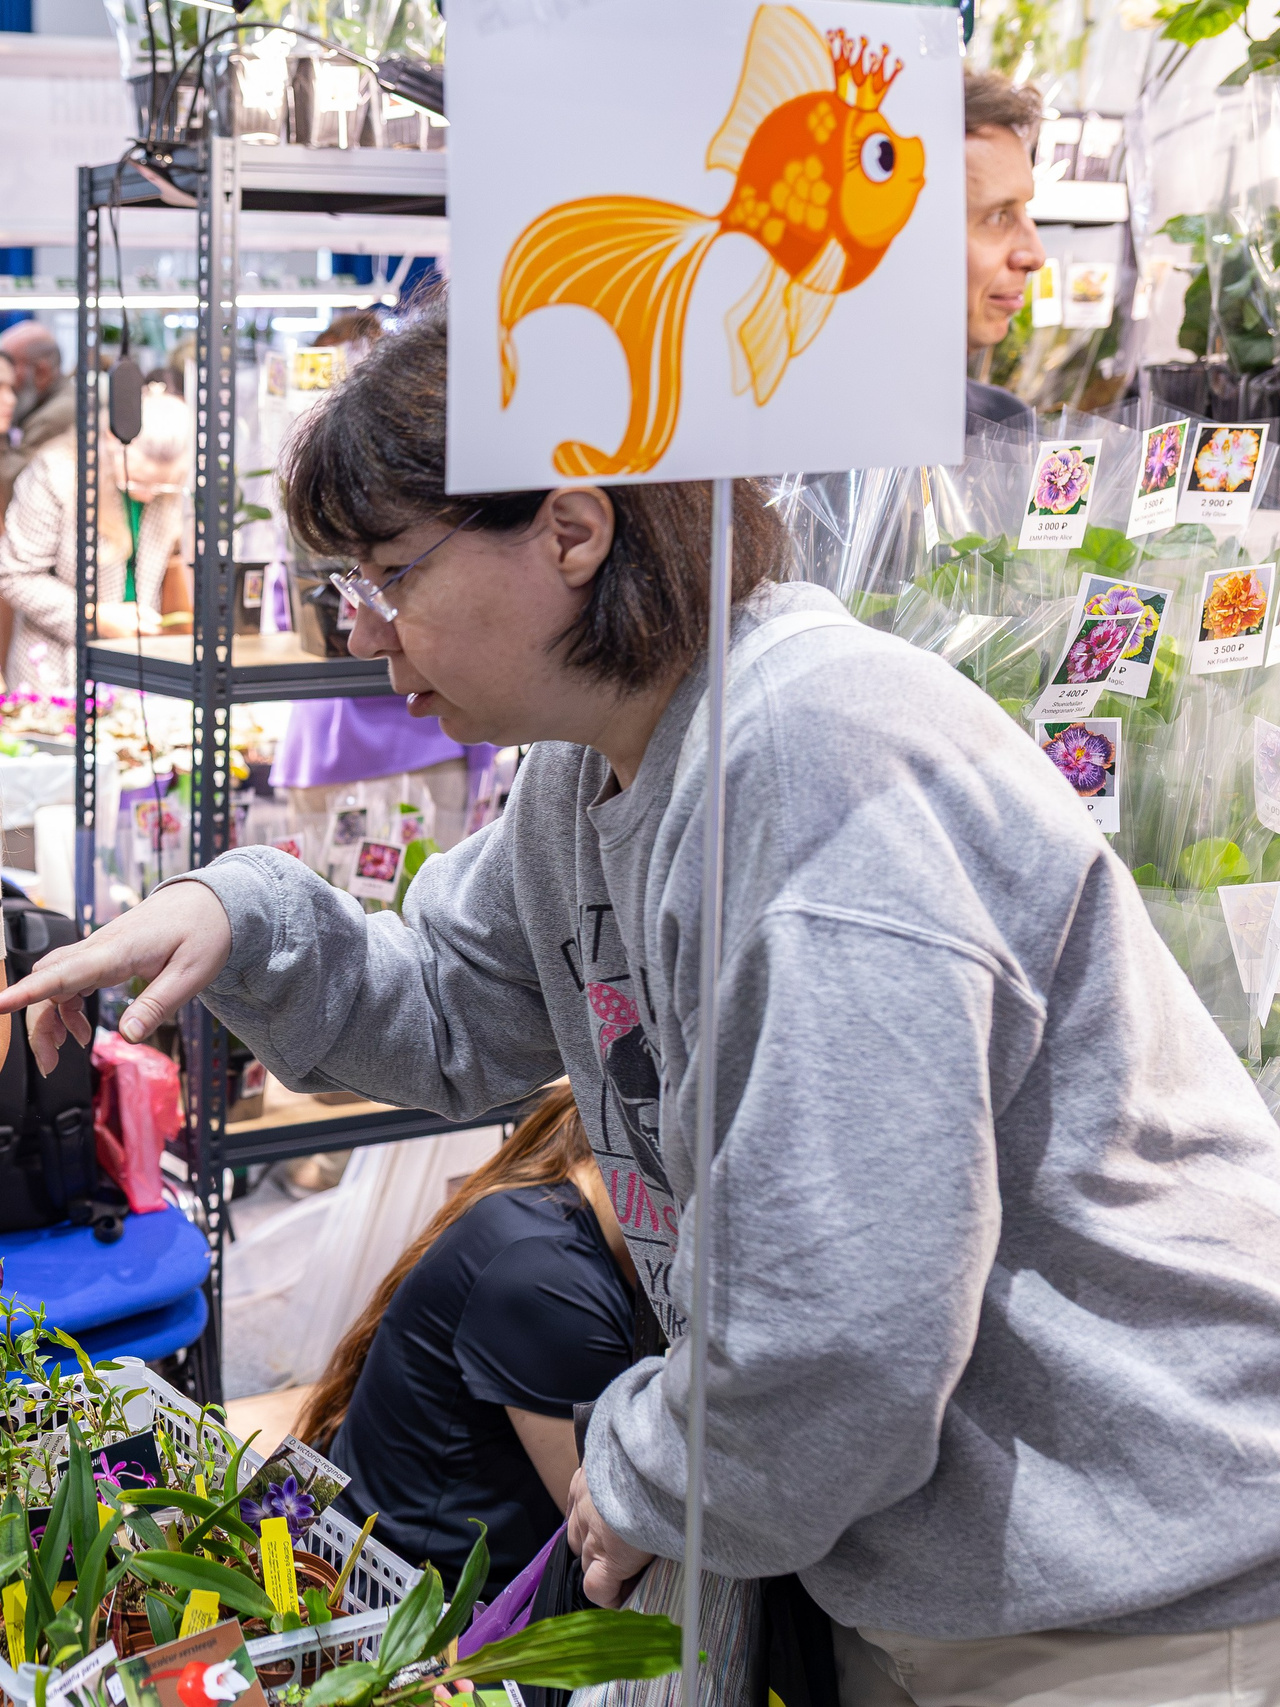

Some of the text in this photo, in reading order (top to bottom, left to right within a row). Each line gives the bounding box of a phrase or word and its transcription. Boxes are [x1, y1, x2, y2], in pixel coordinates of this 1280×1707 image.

[1209, 499, 1225, 507] 900
[1044, 522, 1060, 531] 000
[1043, 534, 1059, 542] Pretty
[1221, 644, 1236, 654] 500
[1066, 689, 1081, 697] 400
